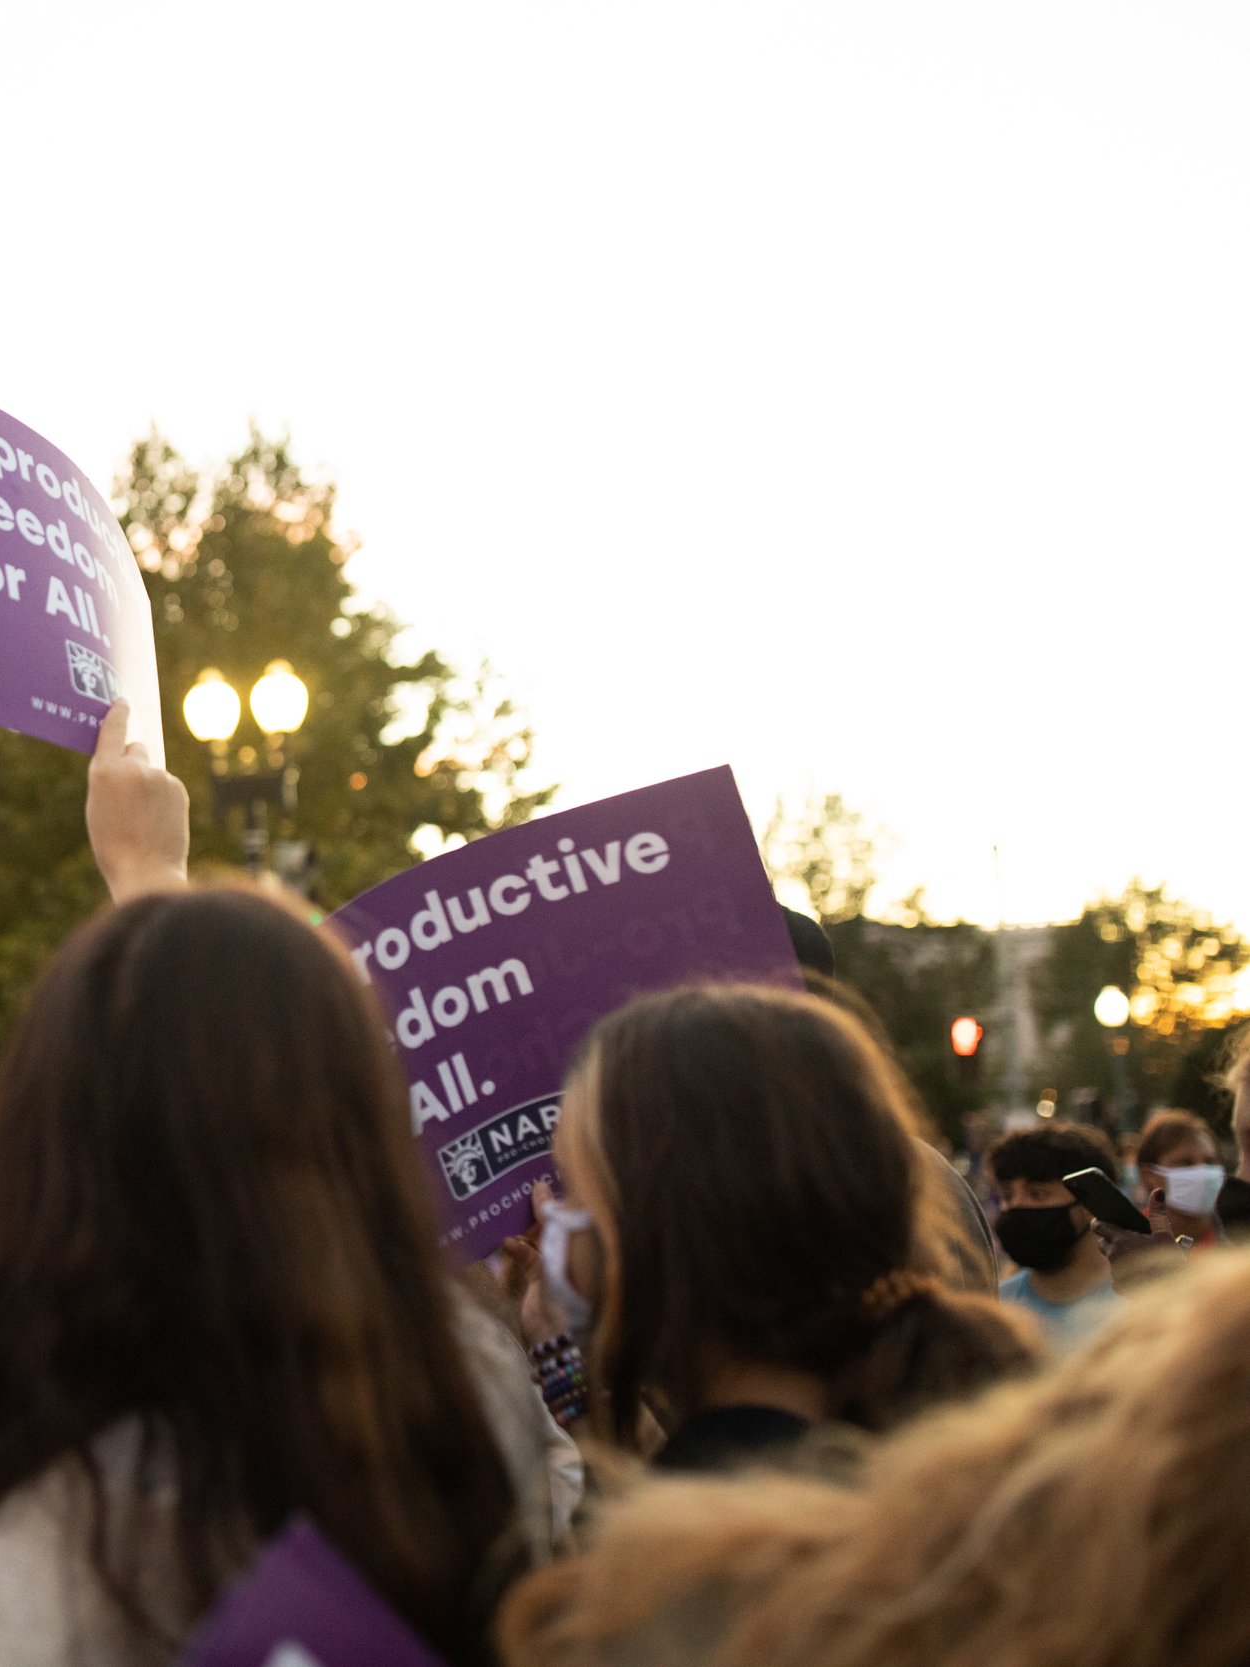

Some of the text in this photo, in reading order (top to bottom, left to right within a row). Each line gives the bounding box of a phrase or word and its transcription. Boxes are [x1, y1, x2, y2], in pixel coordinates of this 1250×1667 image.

[46, 576, 111, 649] All.
[31, 696, 104, 728] WWW.PR
[395, 958, 534, 1049] dom
[409, 1052, 495, 1137] All.
